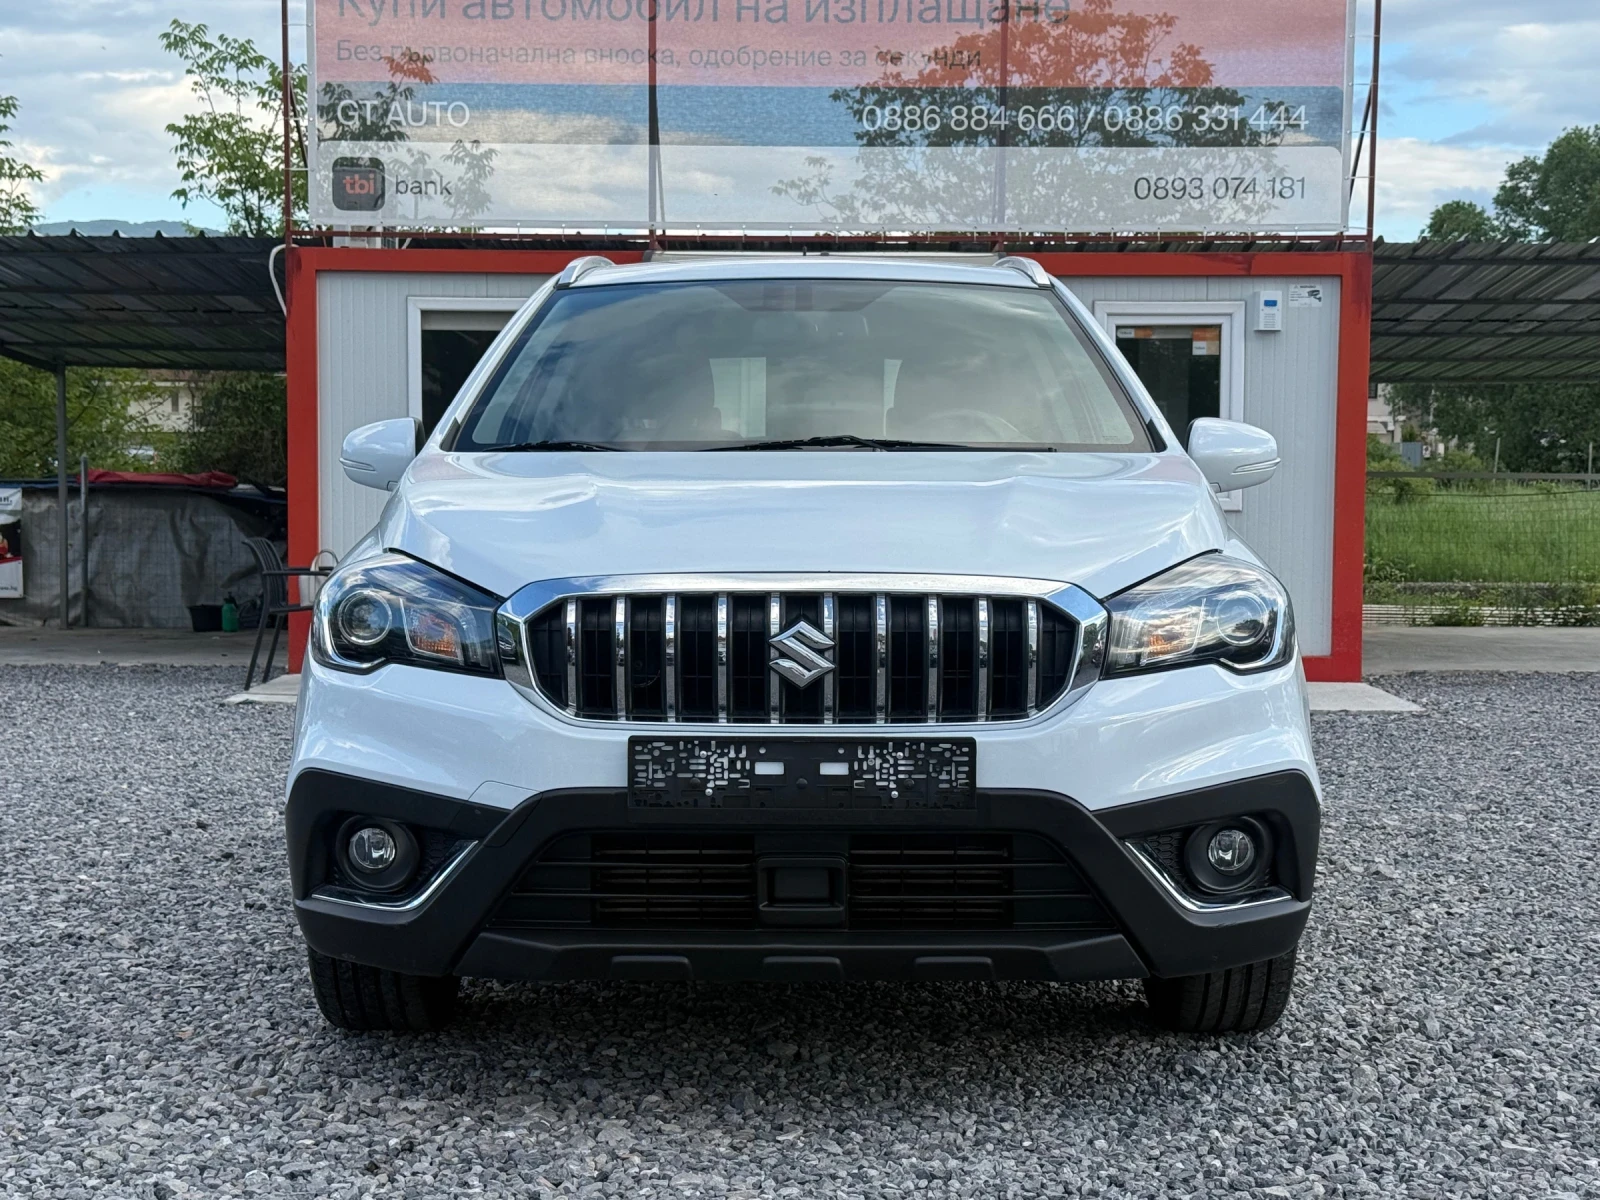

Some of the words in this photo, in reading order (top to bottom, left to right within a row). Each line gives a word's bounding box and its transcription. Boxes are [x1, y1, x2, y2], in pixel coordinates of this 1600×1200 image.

[462, 0, 718, 22] автомобил
[736, 0, 788, 23] на
[805, 0, 1070, 29] изплащане
[337, 40, 382, 61] Без
[391, 45, 576, 66] първоначална
[584, 48, 681, 67] вноска,
[689, 45, 832, 69] одобрение
[839, 50, 867, 66] за
[875, 50, 980, 69] секунди
[337, 99, 379, 126] GT
[386, 101, 471, 127] AUTO
[862, 105, 941, 131] 0886
[950, 105, 1009, 131] 884
[1017, 105, 1075, 131] 666
[1083, 105, 1096, 132] /
[1103, 105, 1183, 131] 0886
[1192, 105, 1240, 131] 331
[1248, 105, 1309, 131] 444
[343, 173, 375, 195] tbi
[395, 175, 452, 195] bank
[1134, 176, 1204, 200] 0893
[1212, 177, 1260, 200] 074
[1267, 177, 1306, 199] 181
